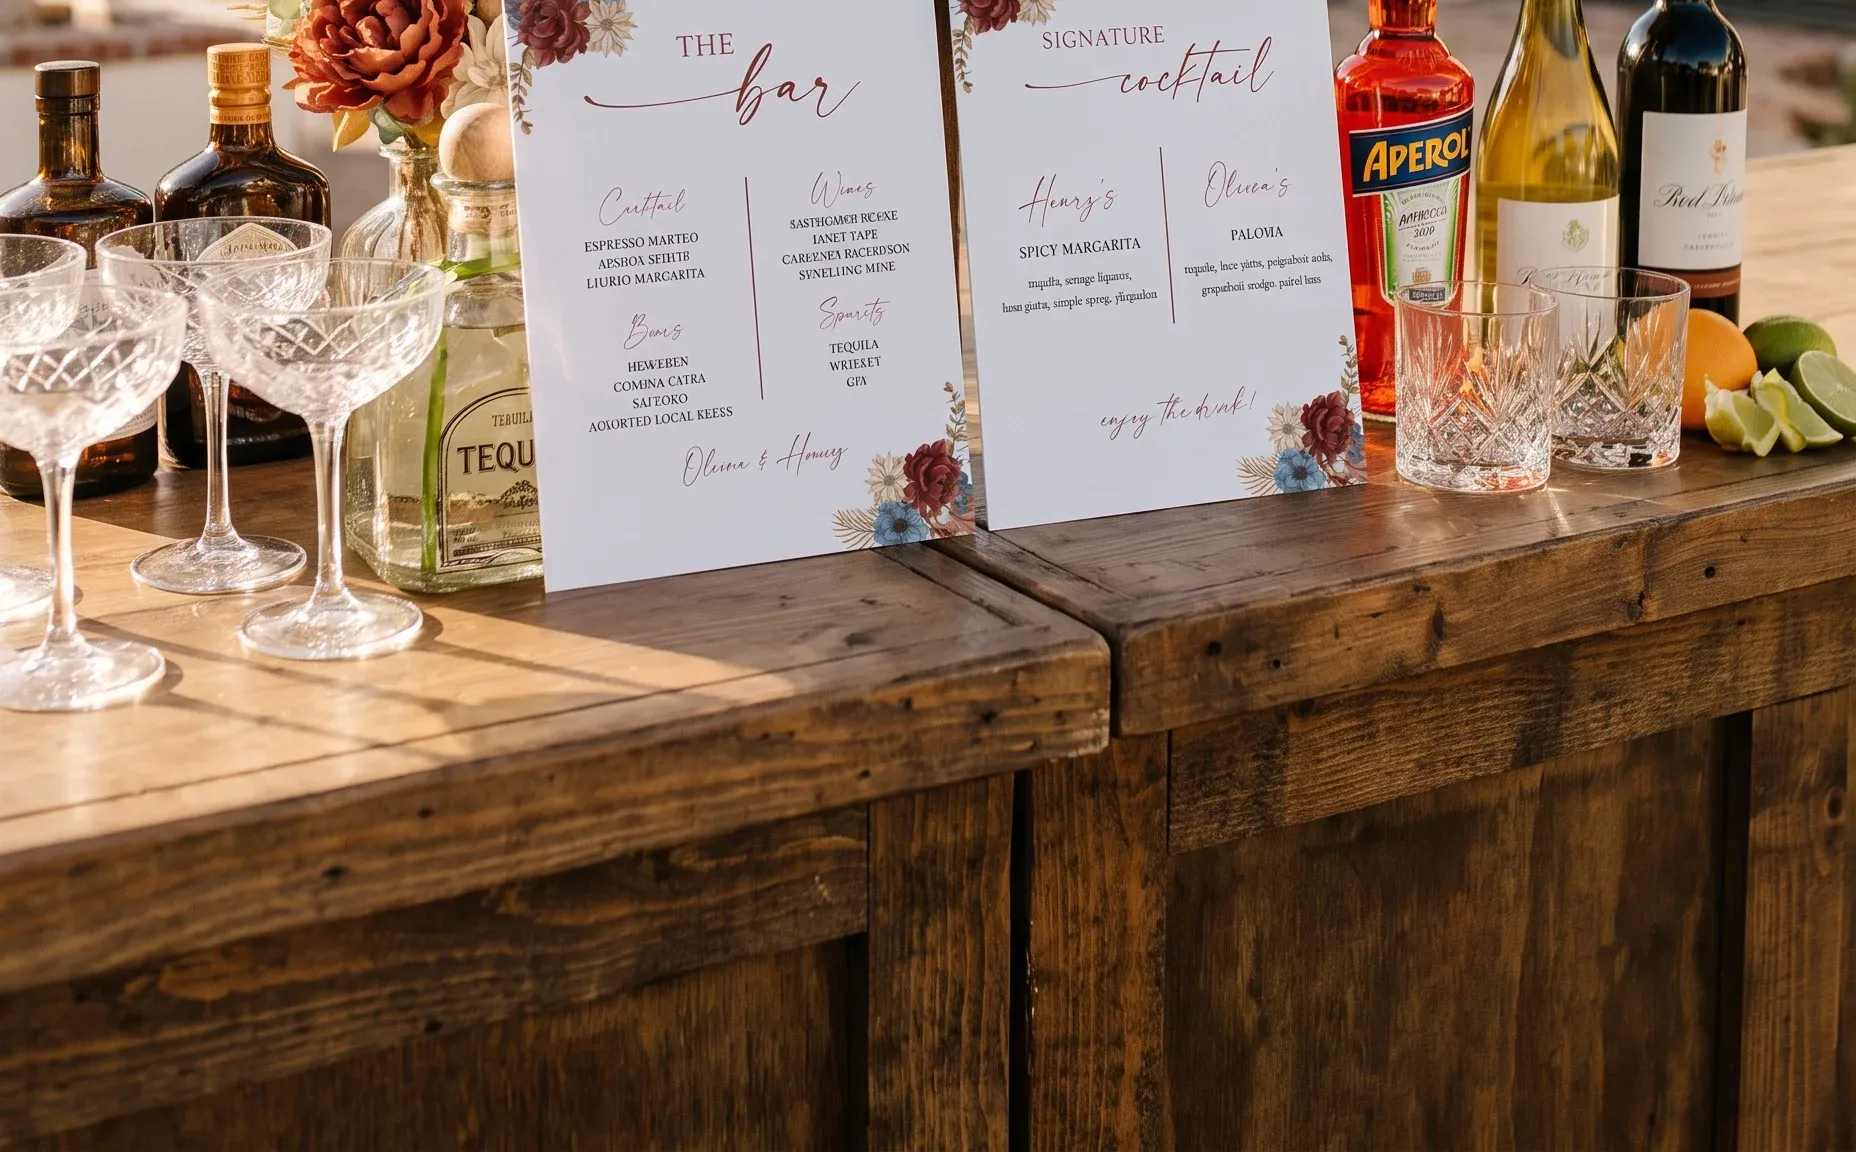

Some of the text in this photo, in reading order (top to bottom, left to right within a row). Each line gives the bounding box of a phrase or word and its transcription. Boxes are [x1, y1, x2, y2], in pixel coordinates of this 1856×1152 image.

[676, 32, 735, 58] THE
[1042, 25, 1165, 49] SIGNATURE
[1025, 36, 1274, 102] cocktail
[1363, 128, 1469, 183] APEROL
[811, 171, 877, 208] Wines
[1018, 174, 1119, 227] Henry's
[585, 232, 699, 252] ESPRESSO MARTEO
[1020, 237, 1141, 259] SPICY MARGARITA
[865, 261, 896, 273] MINE
[829, 339, 879, 354] TEQUILA
[669, 373, 706, 387] CATRA
[655, 411, 694, 425] LOCAL
[1157, 393, 1192, 425] the
[457, 439, 535, 475] TEQU
